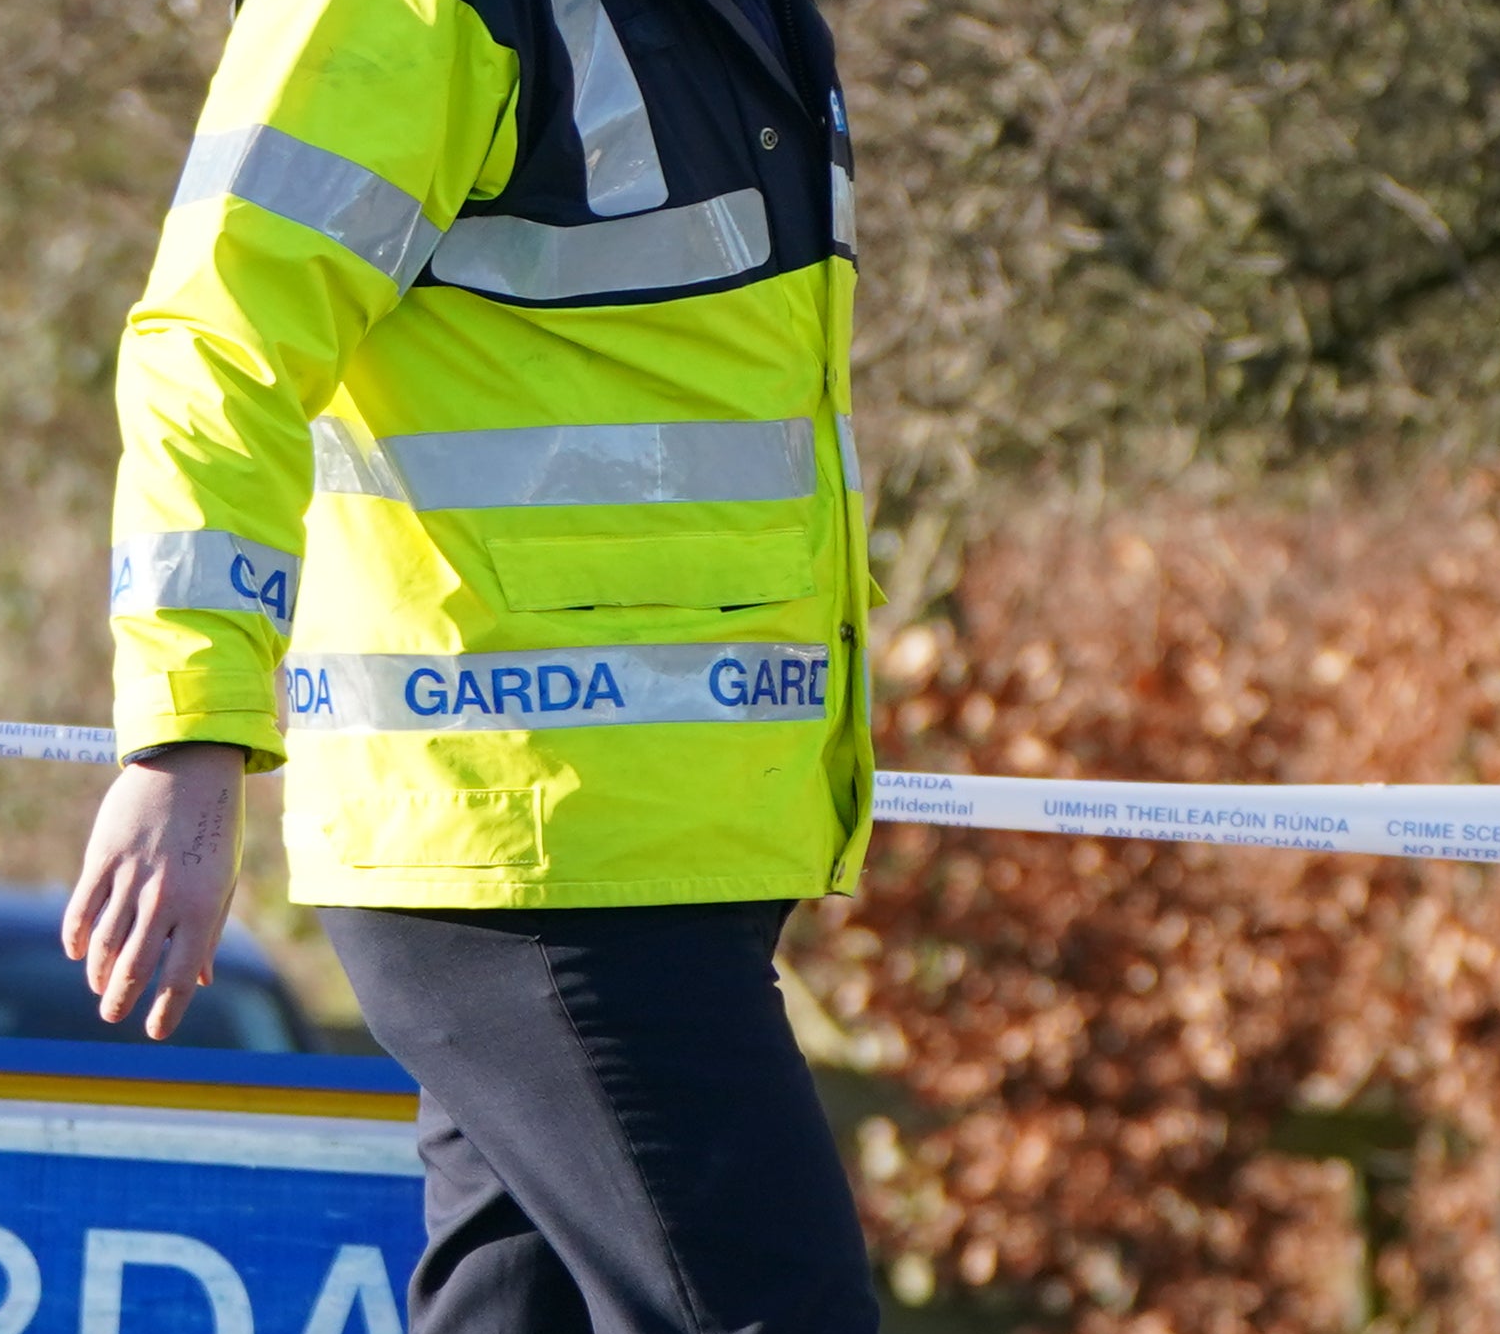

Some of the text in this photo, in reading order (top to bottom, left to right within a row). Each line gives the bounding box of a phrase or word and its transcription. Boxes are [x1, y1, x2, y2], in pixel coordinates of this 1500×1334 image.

[404, 662, 624, 716] GARDA
[877, 773, 953, 790] GARDA
[1044, 800, 1117, 818] UIMHIR
[1387, 820, 1454, 839] CRIME
[1403, 845, 1434, 855] NO
